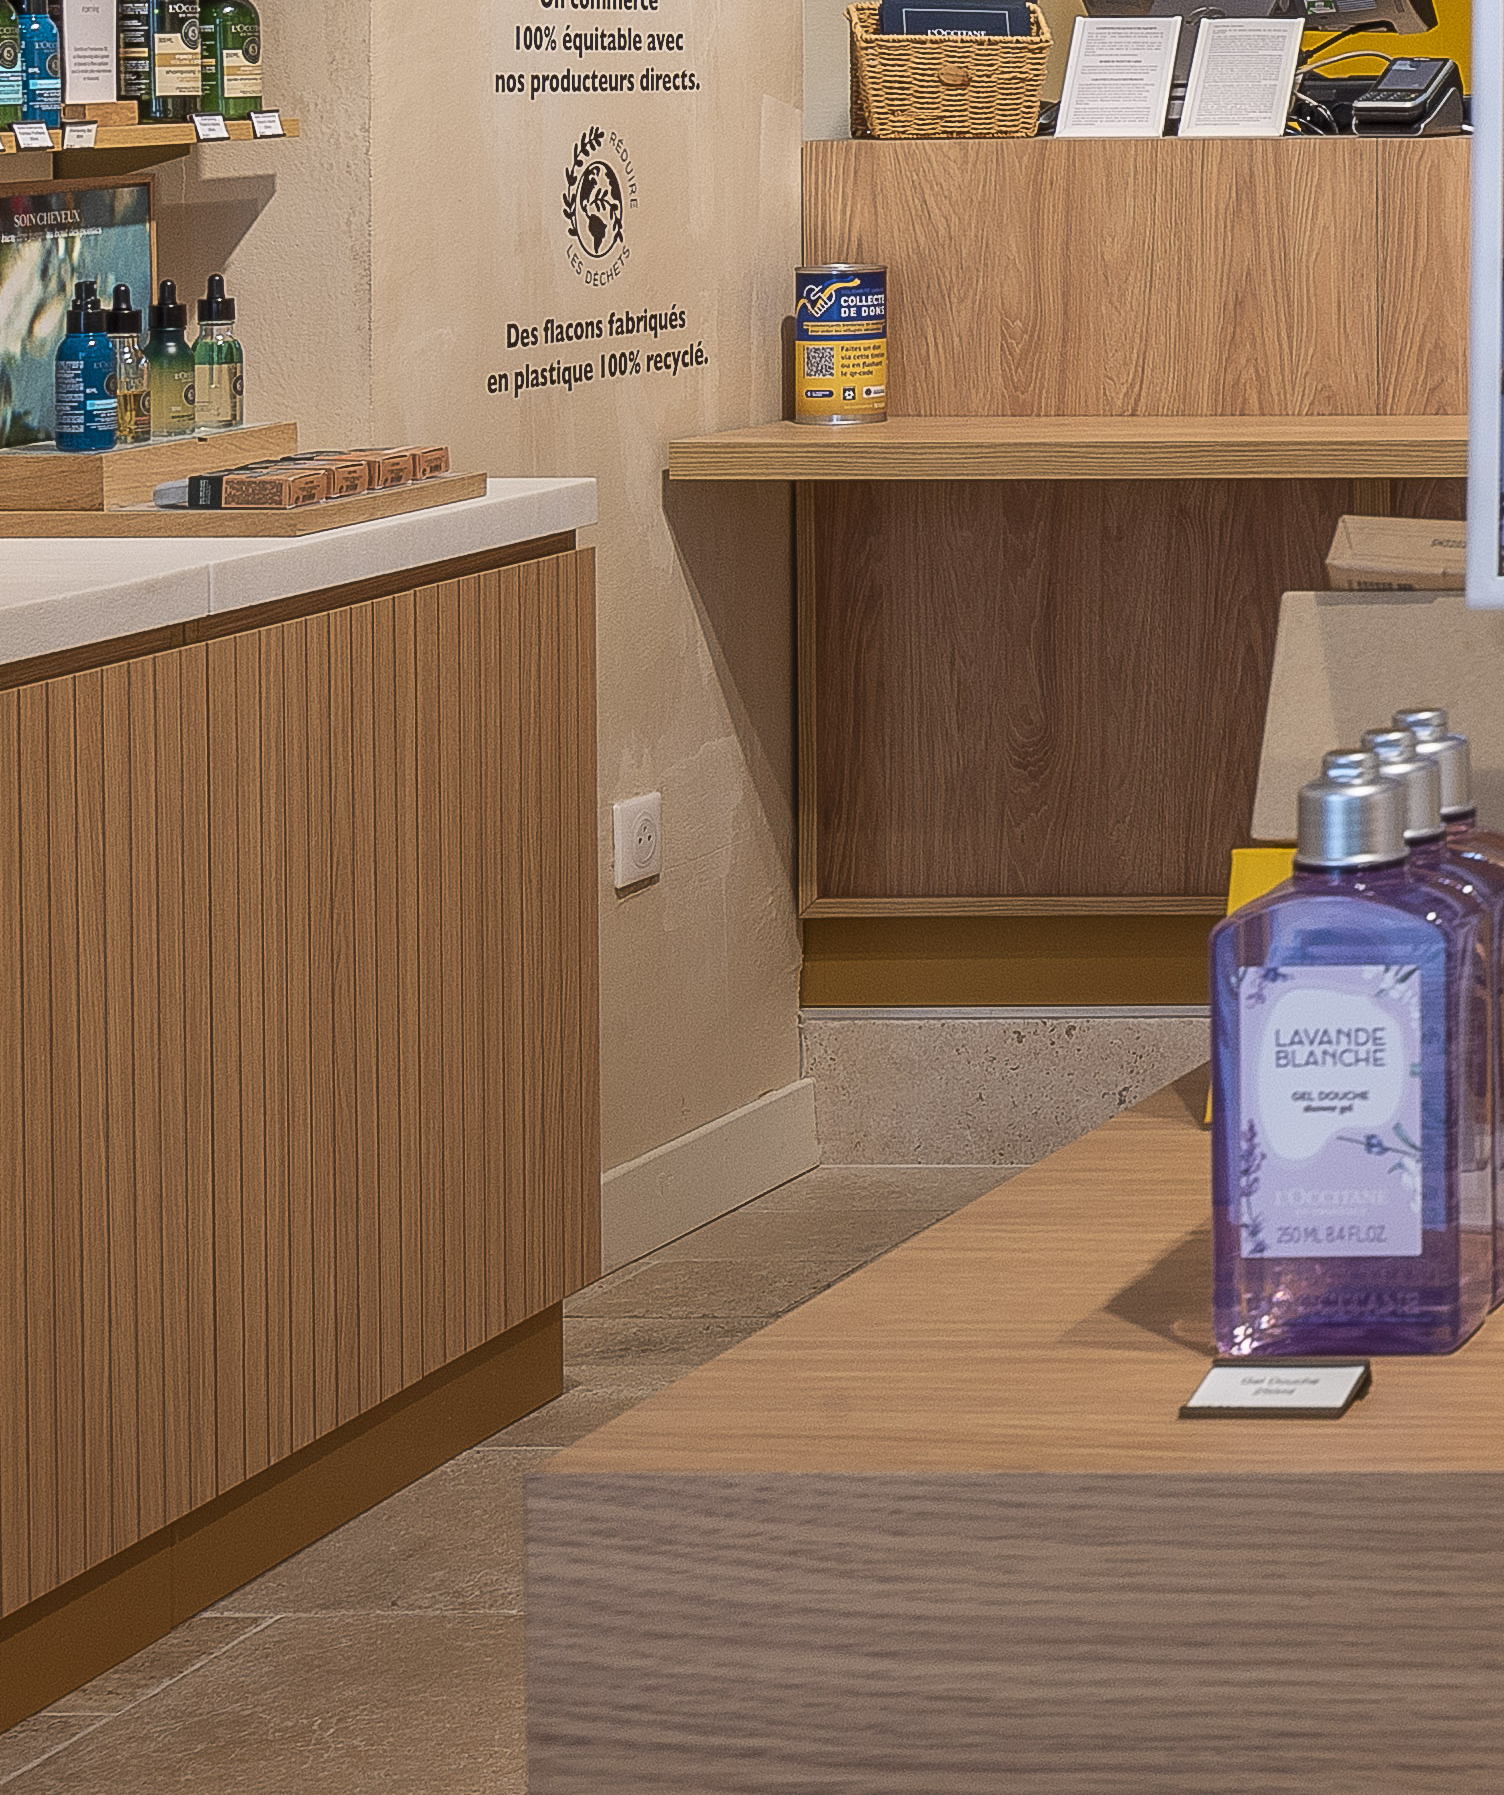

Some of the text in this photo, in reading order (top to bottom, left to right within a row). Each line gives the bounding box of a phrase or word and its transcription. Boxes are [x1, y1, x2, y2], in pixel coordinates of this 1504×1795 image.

[515, 24, 684, 59] 100% équitable avec
[495, 68, 700, 101] nos producteurs directs.
[609, 131, 638, 209] RÉDUIRE
[566, 244, 631, 287] LES DÉCHETS
[840, 294, 885, 306] COLLECTE
[840, 305, 885, 317] DE DONS
[506, 304, 686, 349] Des flacons fabriqués
[487, 341, 709, 398] en plastique 100% recyclé.
[1274, 1027, 1387, 1049] LAVANDE
[1274, 1048, 1387, 1068] BLANCHE
